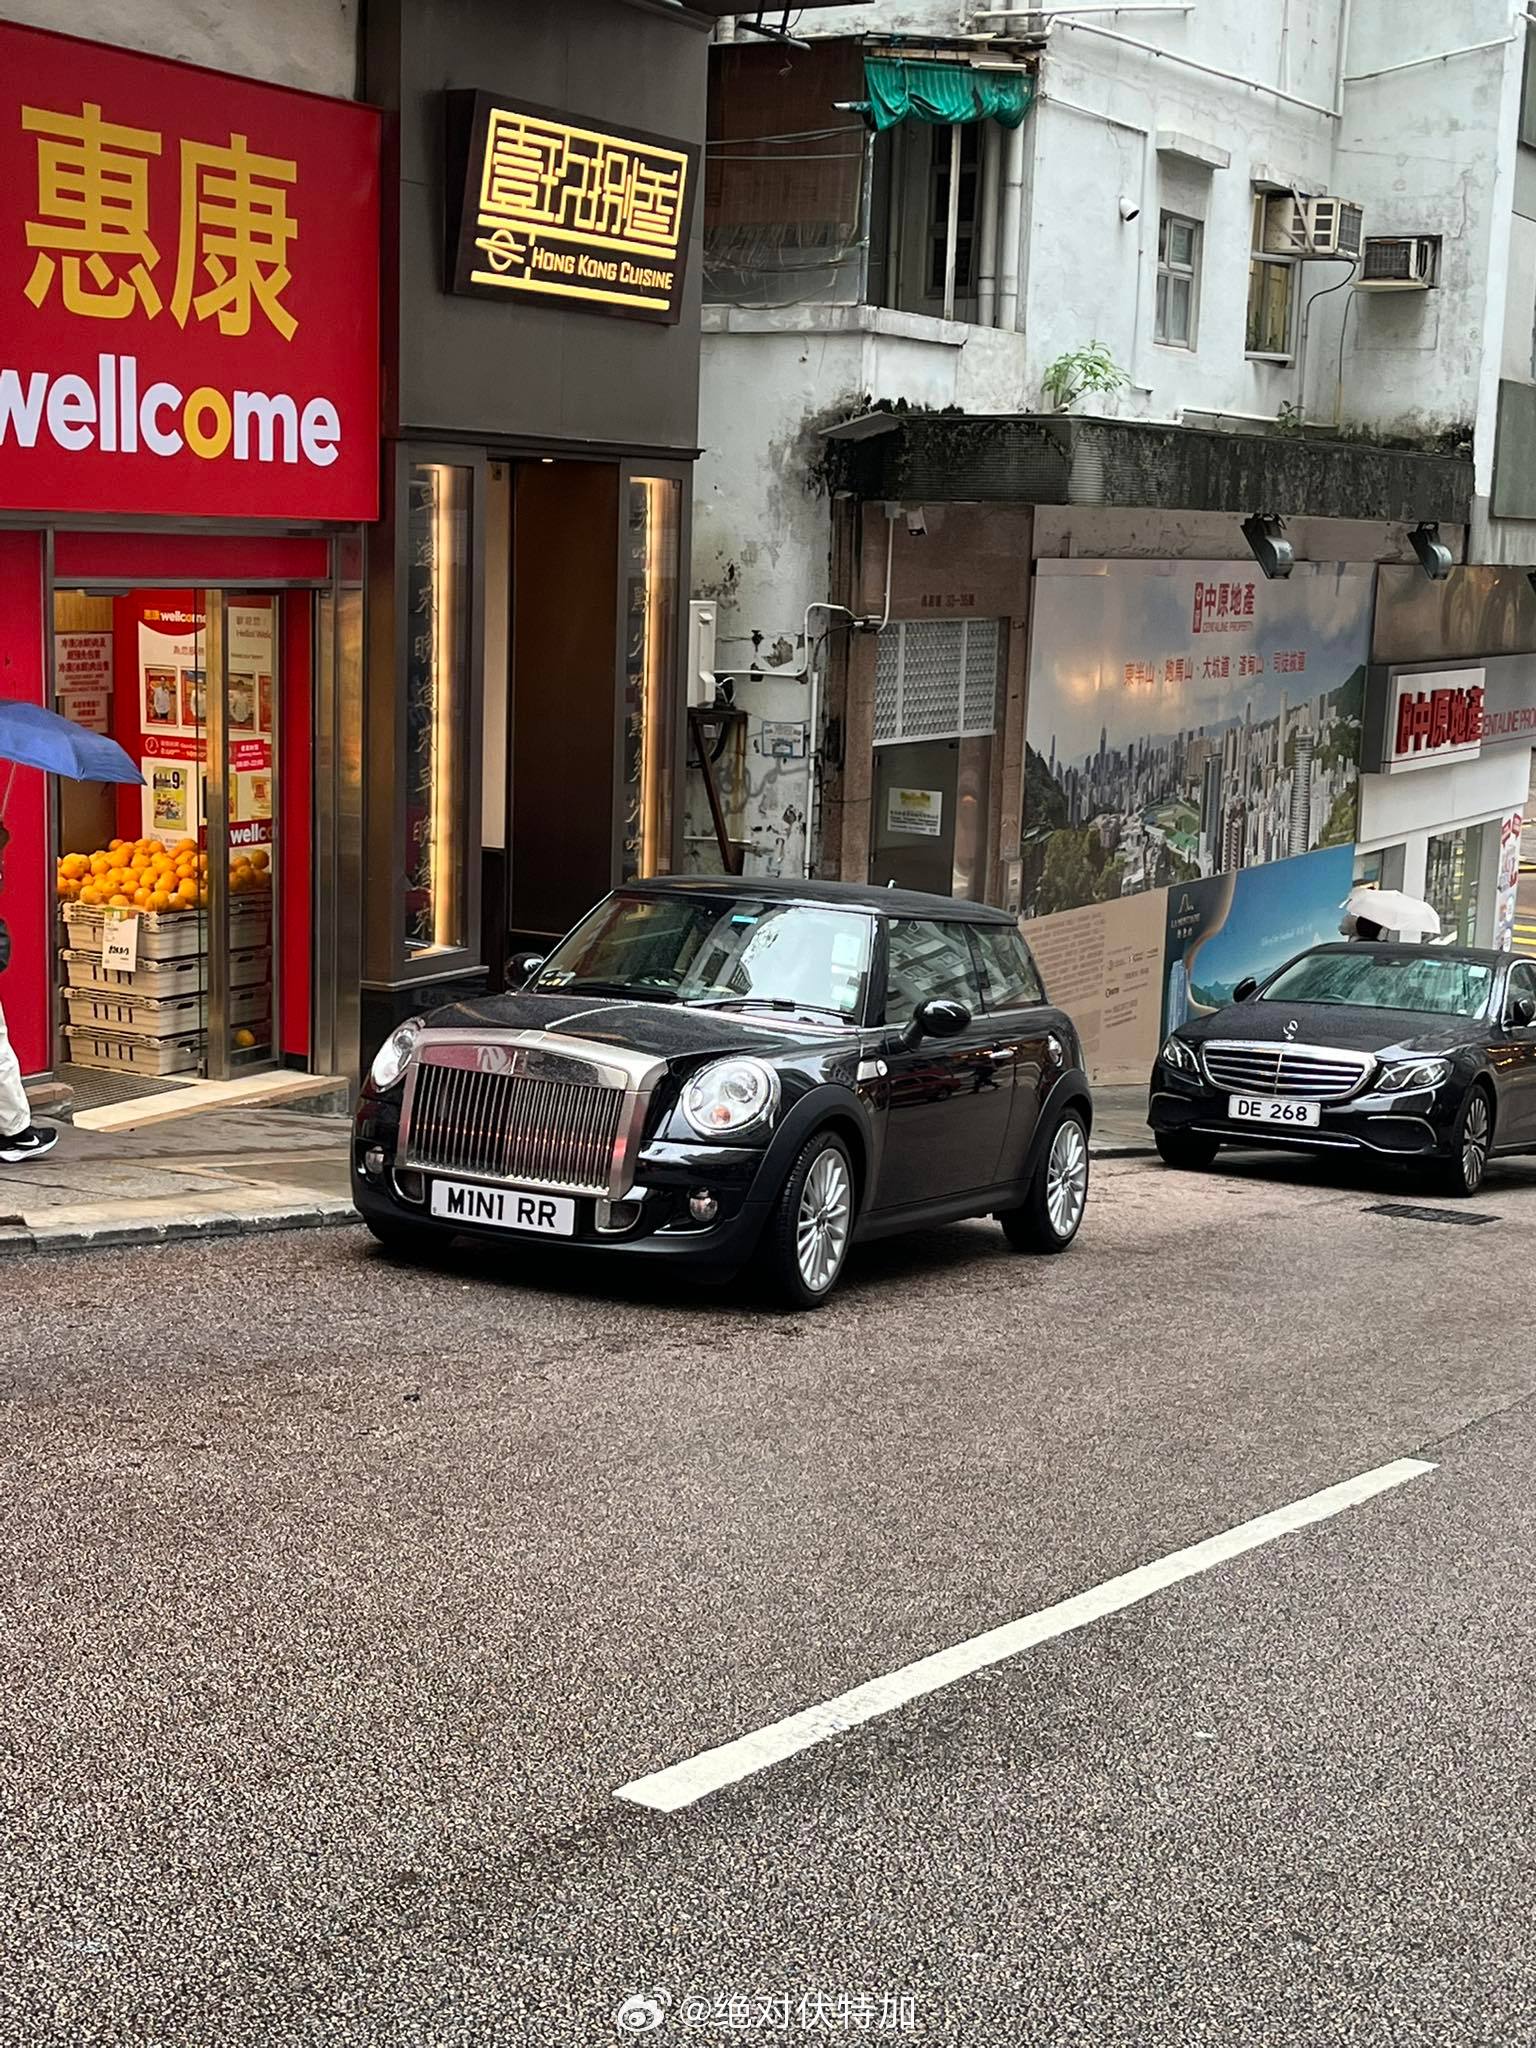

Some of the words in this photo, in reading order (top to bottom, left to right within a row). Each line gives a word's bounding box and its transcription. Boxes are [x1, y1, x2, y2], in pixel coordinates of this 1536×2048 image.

[21, 102, 299, 341] 惠康
[531, 246, 576, 274] HONG
[577, 254, 617, 281] KONG
[619, 261, 674, 290] CUISINE
[0, 353, 341, 466] wellcome
[1204, 583, 1255, 618] 中原地產
[1411, 686, 1485, 751] 中原地產
[1483, 710, 1519, 737] ENTALINE
[1238, 1099, 1262, 1117] DE
[1269, 1103, 1308, 1121] 268
[517, 1197, 557, 1228] RR
